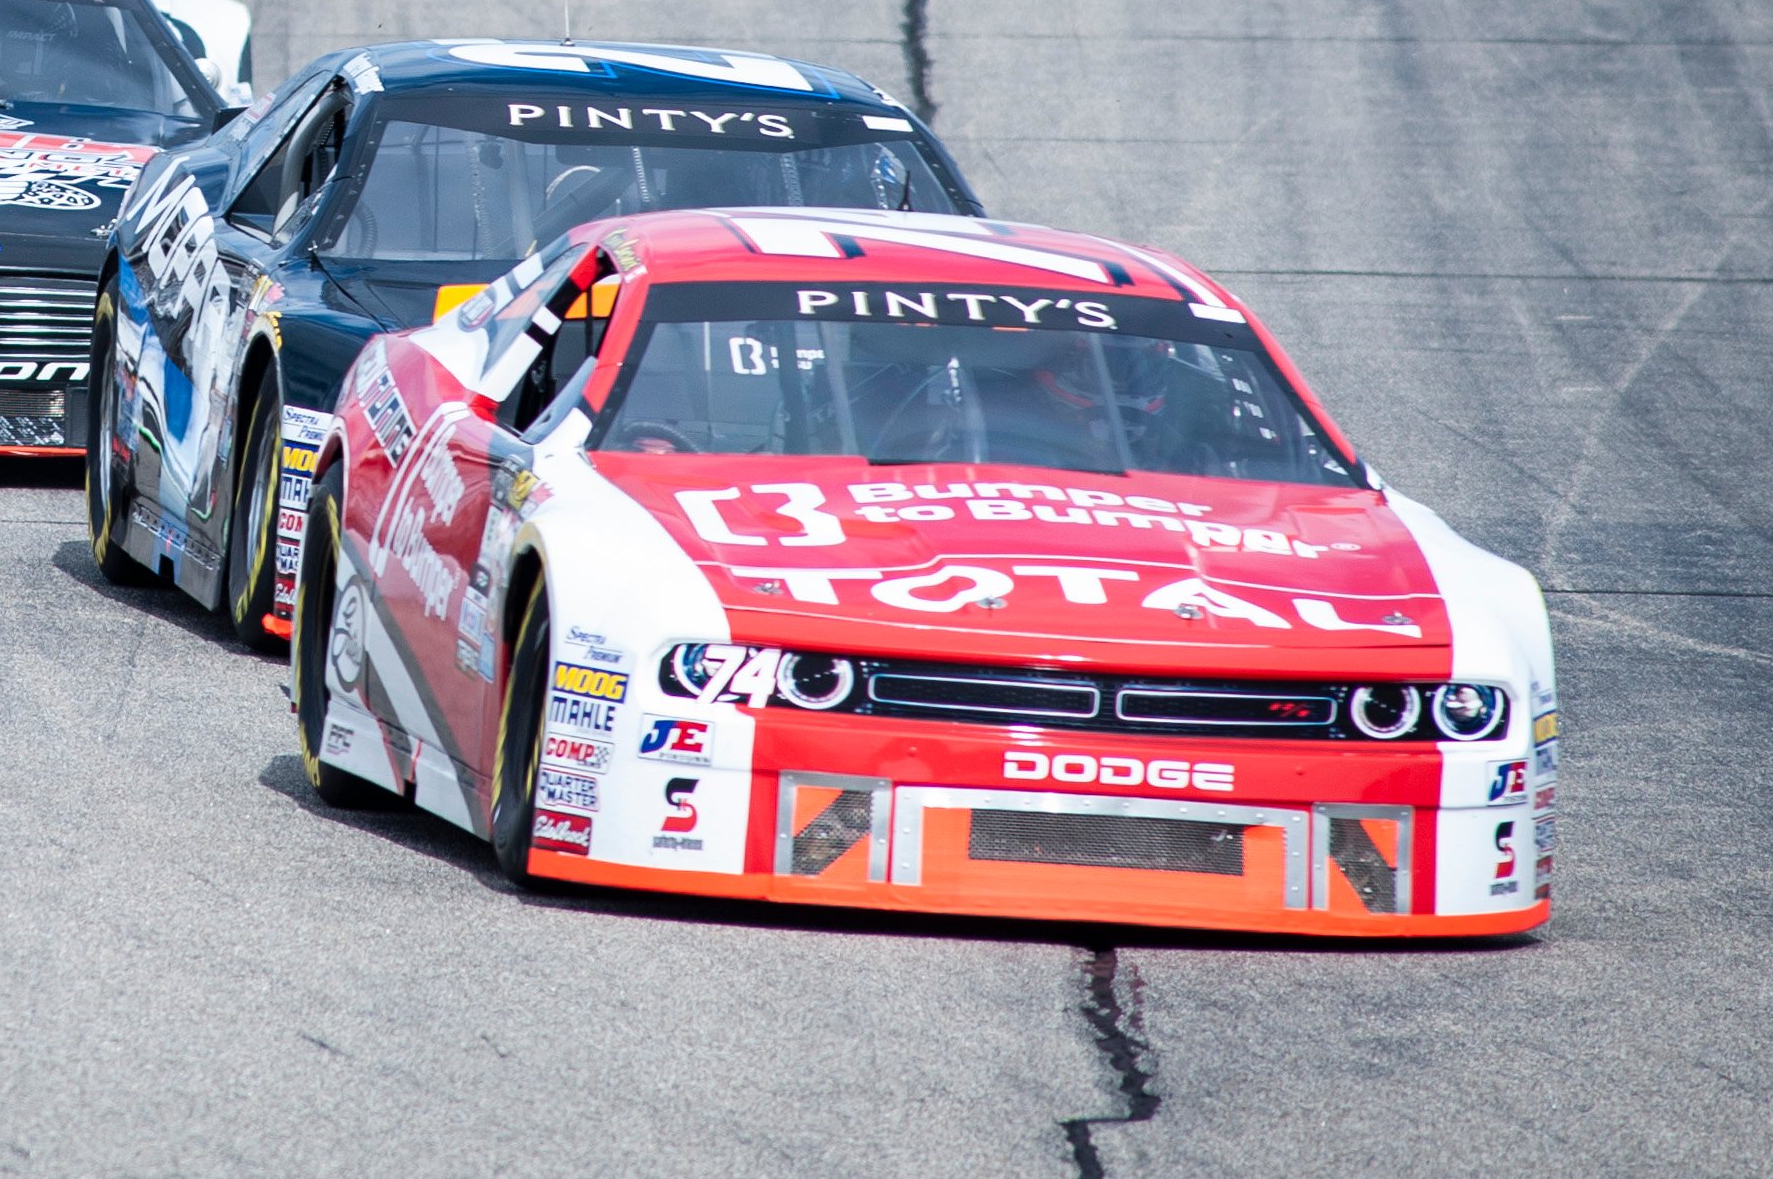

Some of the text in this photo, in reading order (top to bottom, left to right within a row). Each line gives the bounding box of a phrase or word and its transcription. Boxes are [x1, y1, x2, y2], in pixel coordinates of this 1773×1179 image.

[508, 103, 795, 139] PINTY'S
[797, 289, 1118, 330] PINTY'S
[847, 482, 1212, 517] Bumper
[854, 499, 1329, 559] to Bumper
[731, 565, 1422, 638] TOTAL
[555, 665, 626, 700] MOOG
[697, 647, 782, 708] 74
[550, 696, 615, 732] MAHLE
[546, 737, 596, 761] COMP
[640, 720, 709, 754] JE
[541, 771, 596, 793] QUARTER
[1003, 751, 1234, 792] DODGE
[544, 787, 597, 806] MASTER
